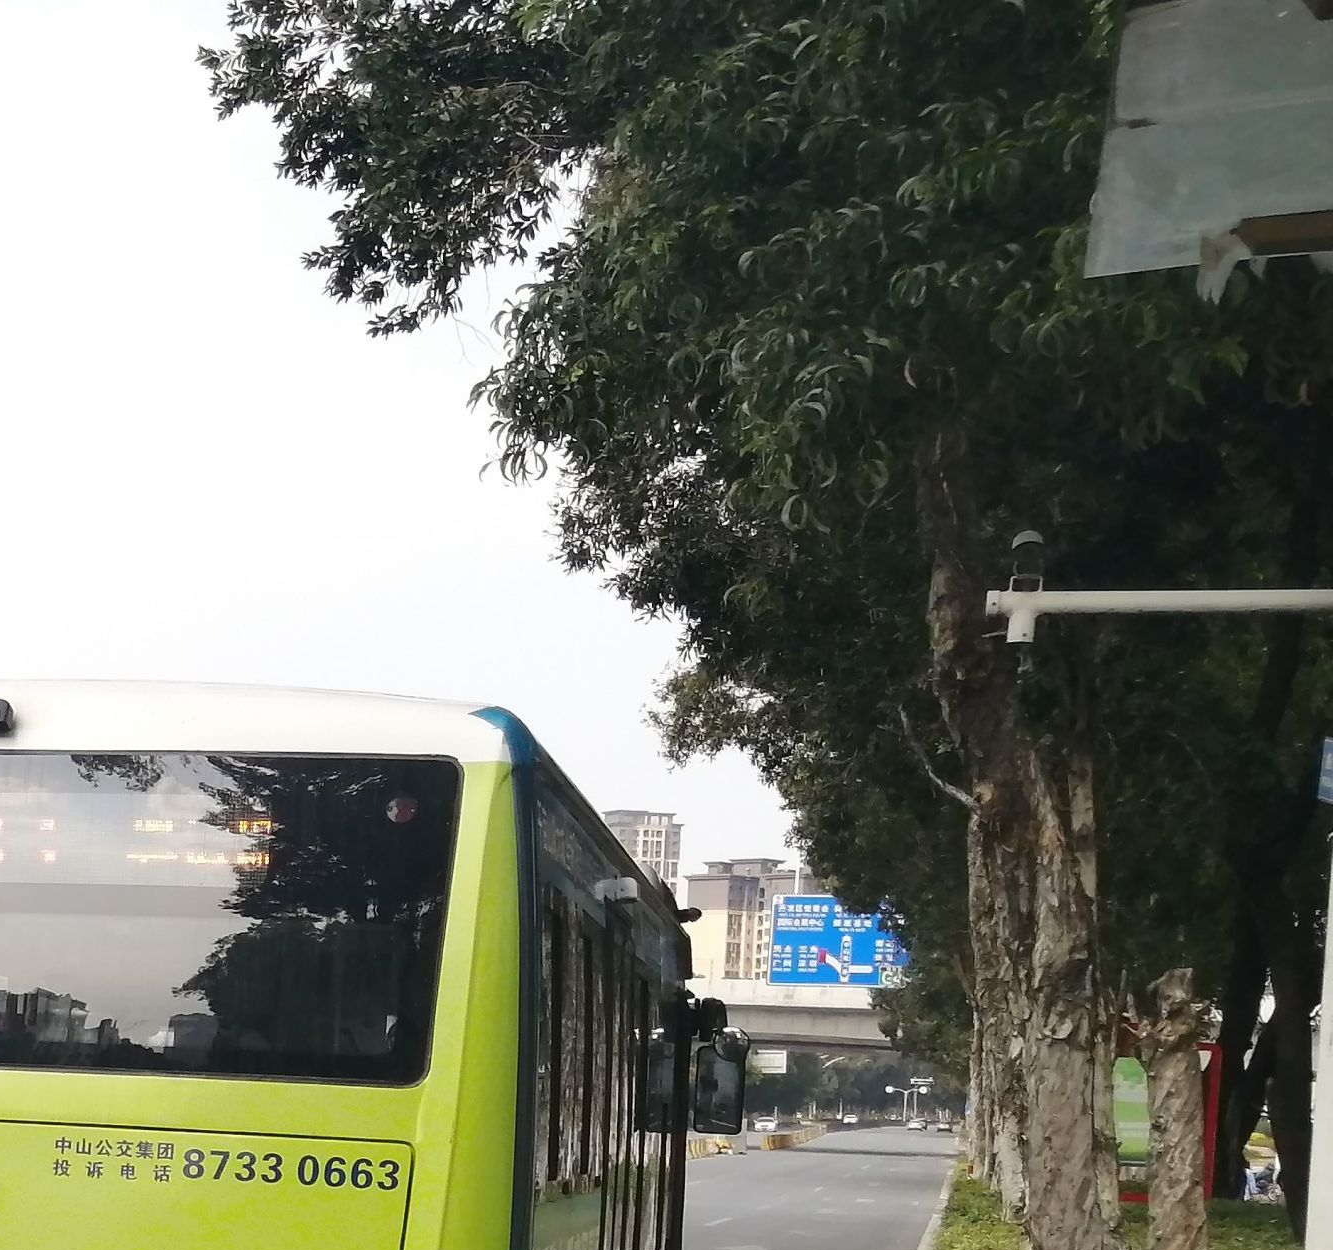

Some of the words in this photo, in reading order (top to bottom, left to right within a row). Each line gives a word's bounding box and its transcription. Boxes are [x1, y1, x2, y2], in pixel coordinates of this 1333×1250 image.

[54, 1136, 175, 1160] 中山公交集团
[53, 1158, 173, 1183] 投诉电话
[182, 1148, 284, 1186] 8733
[297, 1154, 401, 1192] 0663
